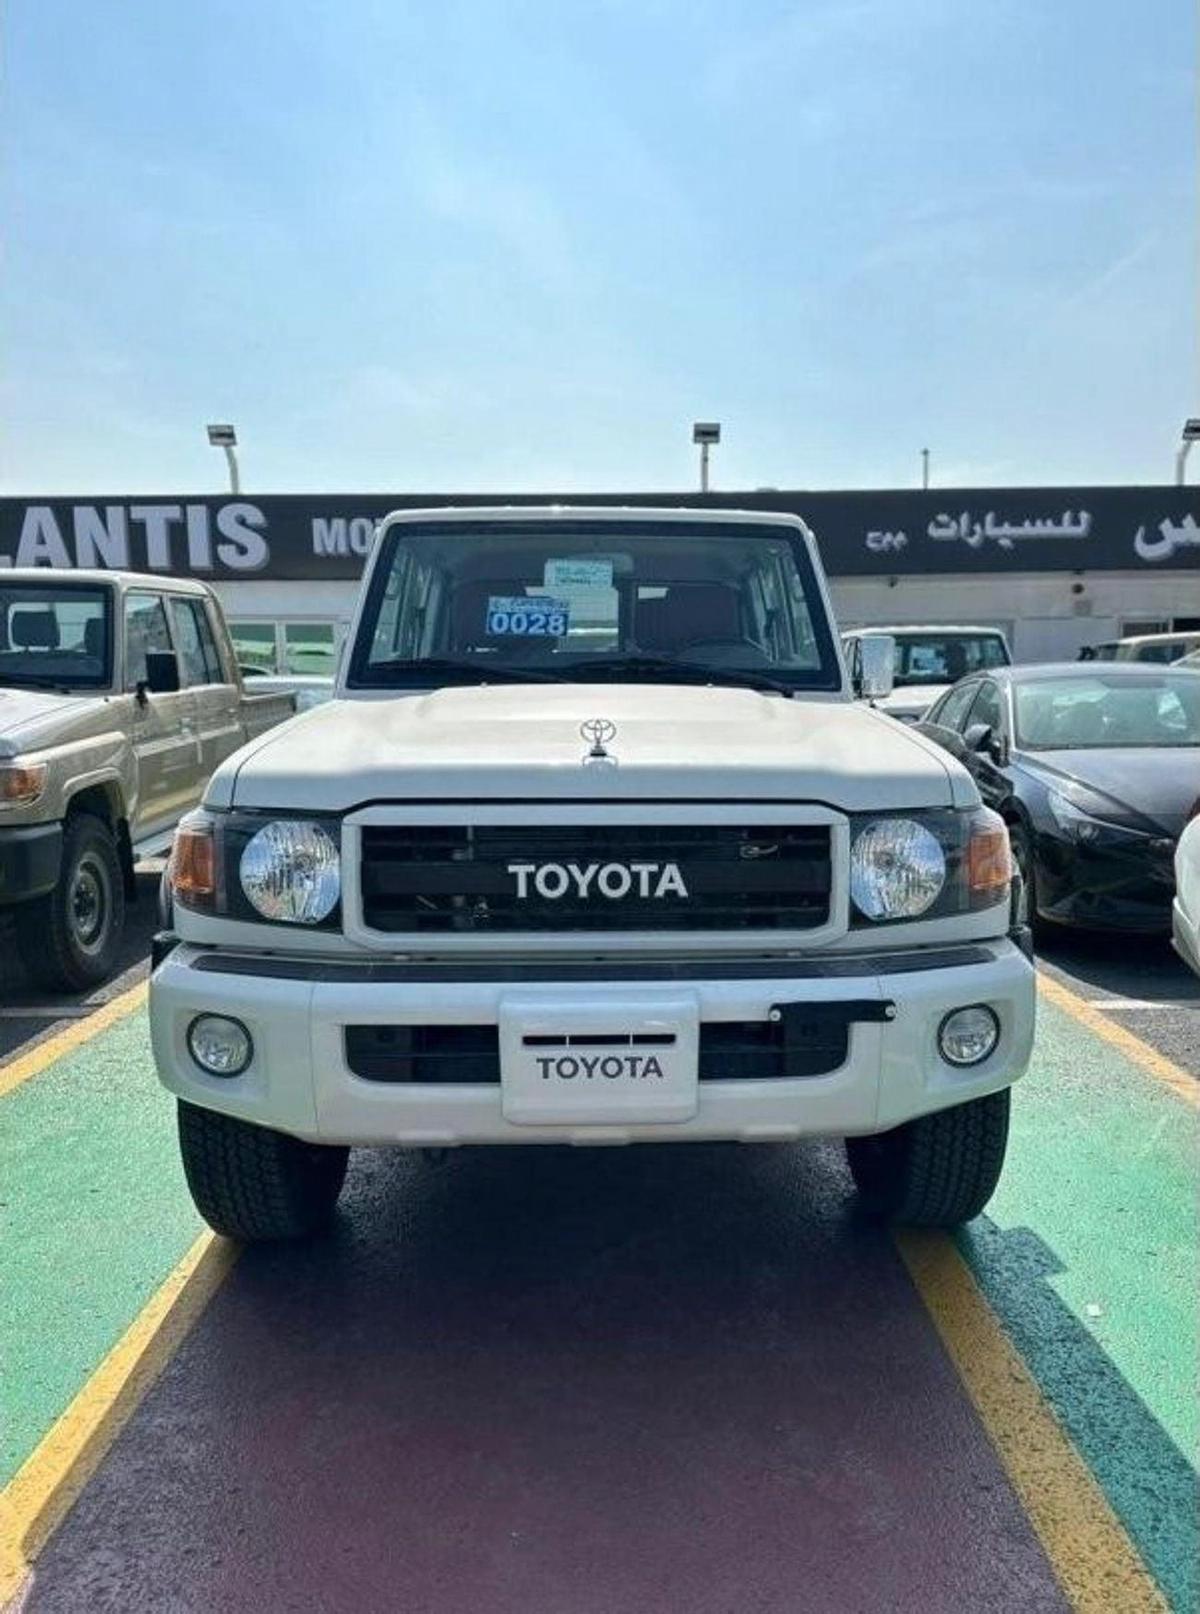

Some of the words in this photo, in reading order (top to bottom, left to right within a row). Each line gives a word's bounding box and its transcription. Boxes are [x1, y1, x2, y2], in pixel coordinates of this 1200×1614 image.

[0, 503, 269, 570] ANTIS
[312, 517, 384, 556] MO
[927, 510, 1091, 549] للسيارات
[490, 613, 567, 636] 0028
[508, 863, 689, 899] TOYOTA
[536, 1056, 663, 1079] TOYOTA
